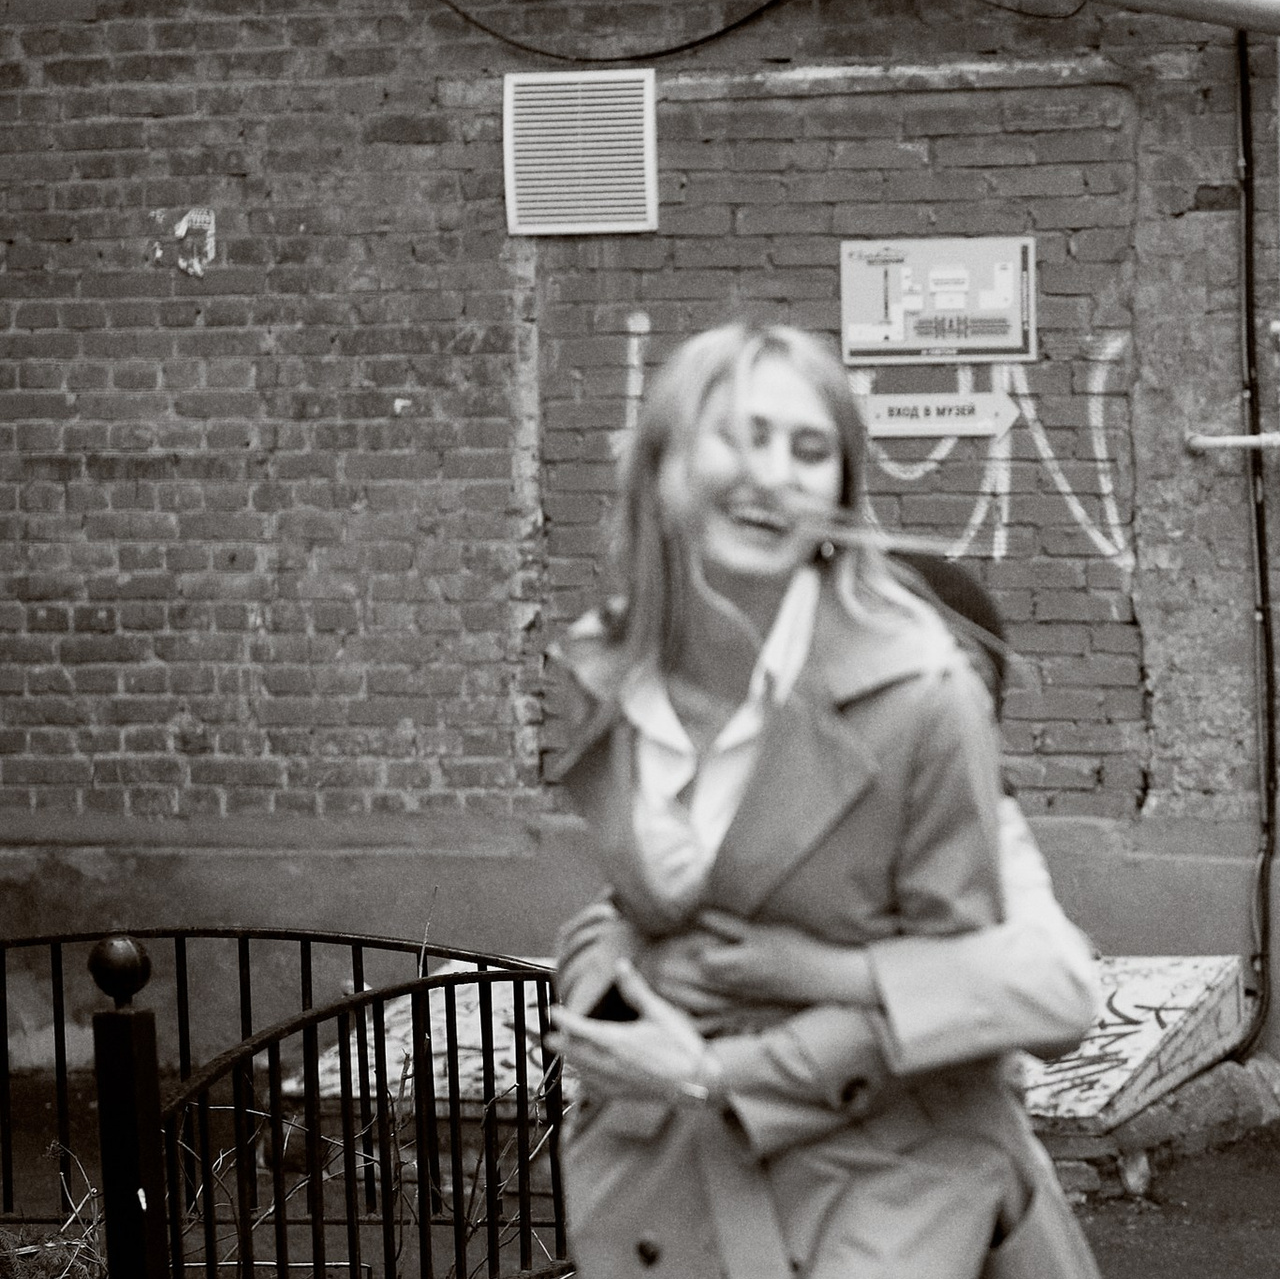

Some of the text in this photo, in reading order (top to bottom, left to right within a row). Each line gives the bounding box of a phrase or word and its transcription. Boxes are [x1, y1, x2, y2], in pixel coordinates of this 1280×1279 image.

[887, 403, 976, 419] ВХОД В МУЗЕЙ
